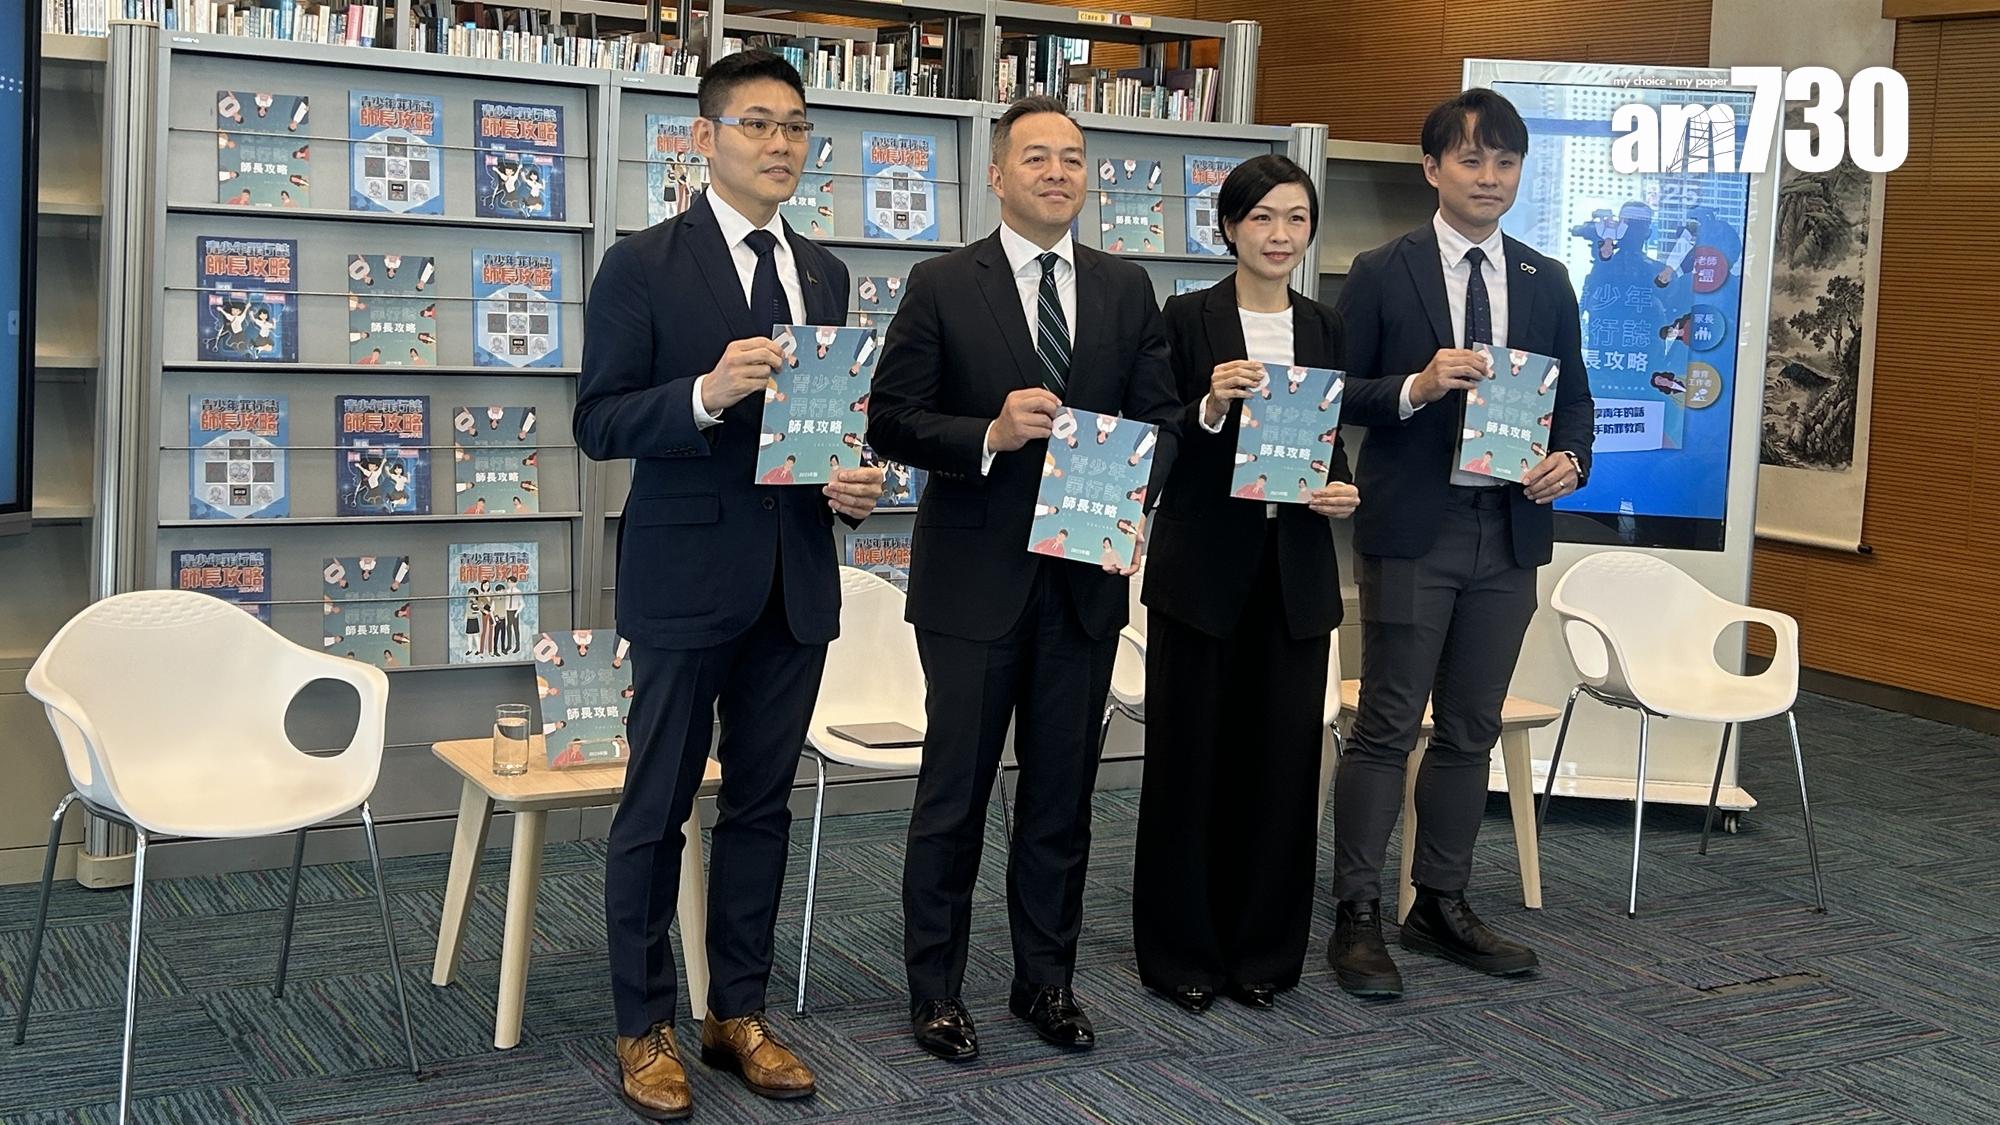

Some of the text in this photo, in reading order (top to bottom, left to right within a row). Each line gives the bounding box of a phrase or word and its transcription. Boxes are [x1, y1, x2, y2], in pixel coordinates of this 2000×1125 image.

[360, 107, 433, 131] 師長攻略
[482, 117, 557, 141] 師長攻略
[871, 147, 928, 167] 師長攻略
[240, 161, 288, 175] 師長攻略
[1115, 215, 1149, 226] 師長攻略
[205, 255, 290, 277] 師長攻略
[1696, 256, 1718, 267] 老師
[483, 265, 552, 287] 師長攻略
[370, 321, 416, 334] 師長攻略
[1694, 313, 1715, 325] 家長
[200, 410, 278, 432] 師長攻略
[343, 412, 423, 433] 師長攻略
[787, 419, 842, 434] 師長攻略
[1486, 420, 1532, 441] 師長攻略
[1260, 443, 1311, 460] 師長攻略
[475, 471, 519, 482] 師長攻略
[1061, 495, 1118, 518] 師長攻略
[180, 566, 264, 589] 師長攻略
[458, 563, 529, 583] 師長攻略
[345, 624, 391, 636] 師長攻略
[566, 705, 619, 721] 師長攻略
